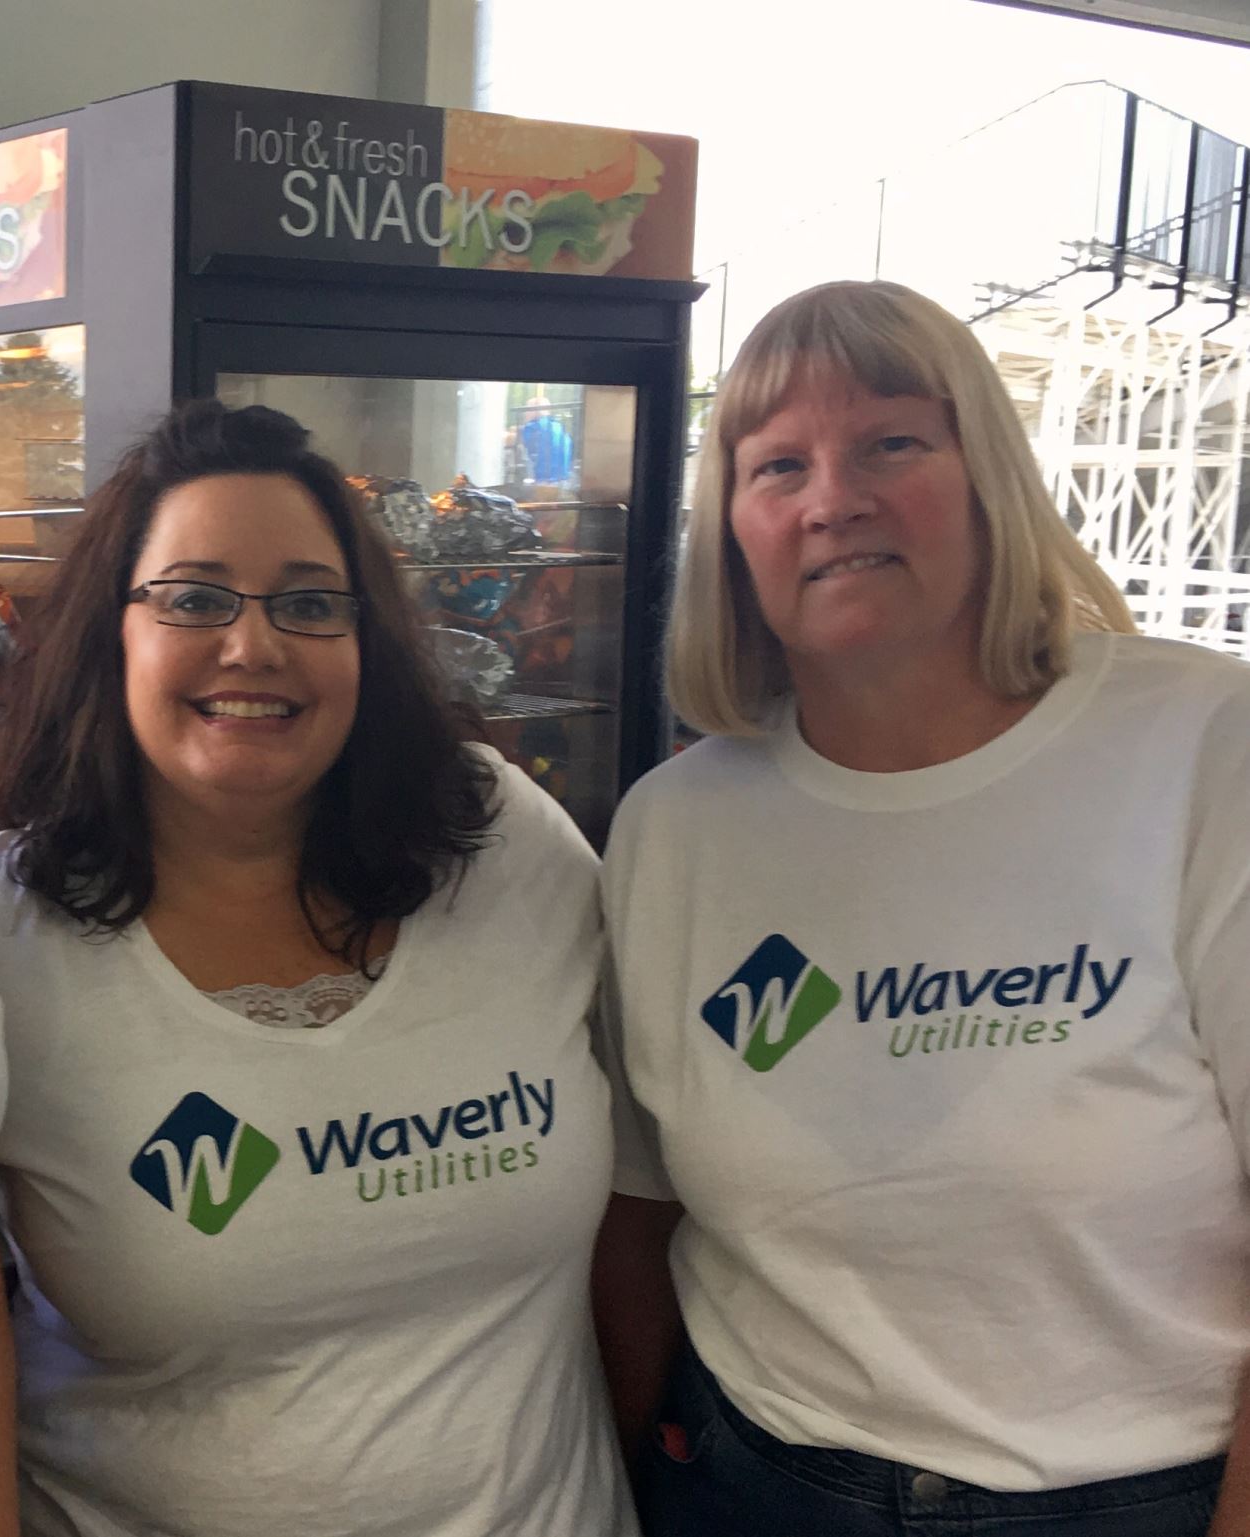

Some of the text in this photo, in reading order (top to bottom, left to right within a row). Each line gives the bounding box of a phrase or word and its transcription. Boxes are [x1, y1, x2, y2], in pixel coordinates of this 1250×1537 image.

[279, 169, 534, 253] SNACKS
[855, 943, 1133, 1024] Waverly
[888, 1012, 1072, 1058] Utilities
[295, 1070, 555, 1176] Waverly
[357, 1141, 540, 1203] Utilities
